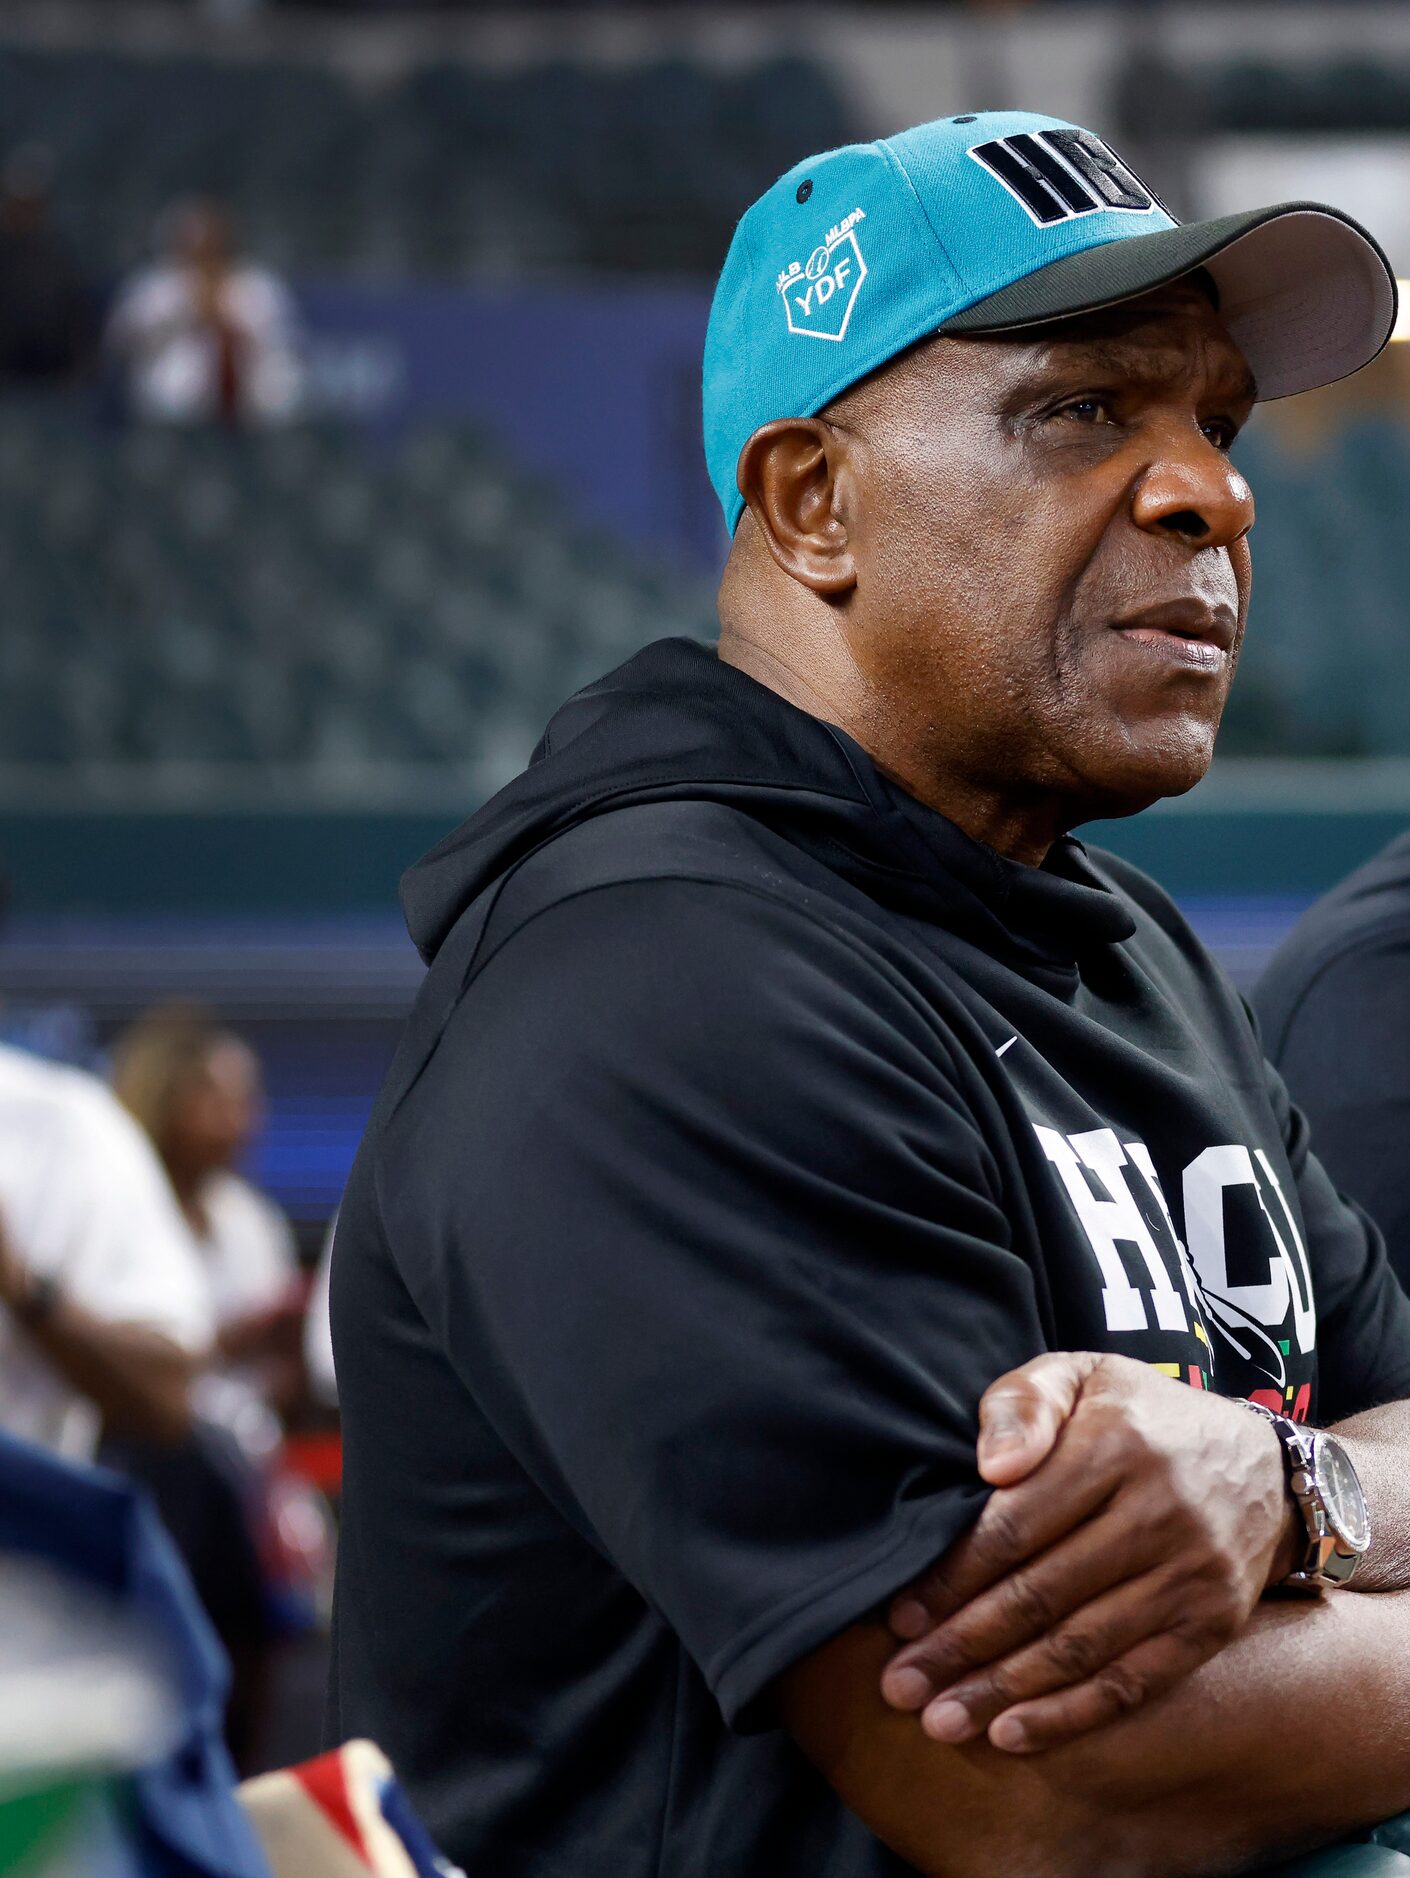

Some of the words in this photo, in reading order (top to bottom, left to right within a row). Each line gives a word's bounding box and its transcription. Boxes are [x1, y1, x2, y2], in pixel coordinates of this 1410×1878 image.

[967, 128, 1182, 229] HB
[776, 261, 801, 295] MLB
[825, 207, 867, 247] MLBPA
[795, 257, 851, 316] YDF
